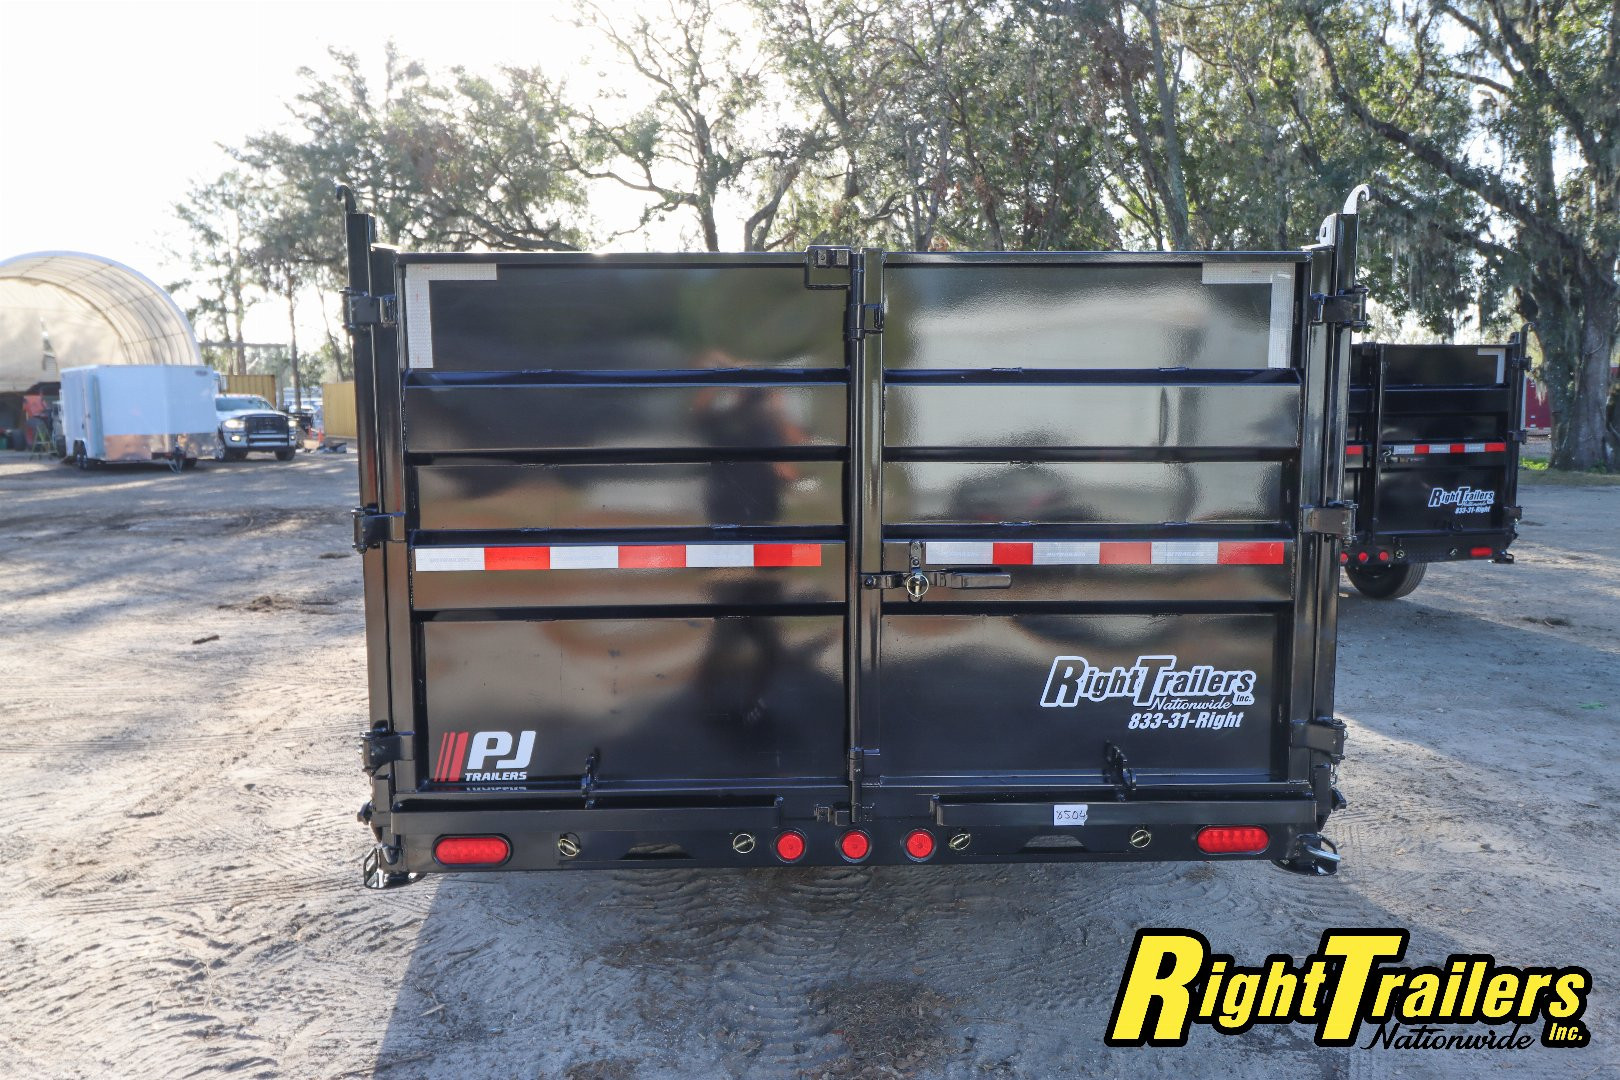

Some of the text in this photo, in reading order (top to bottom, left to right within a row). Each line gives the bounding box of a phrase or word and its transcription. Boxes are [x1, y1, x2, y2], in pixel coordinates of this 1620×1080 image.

[1147, 694, 1253, 711] Nationwide Inc.
[1128, 712, 1244, 730] 833-31-Right
[467, 731, 536, 769] PJ
[465, 772, 527, 781] TRAILERS
